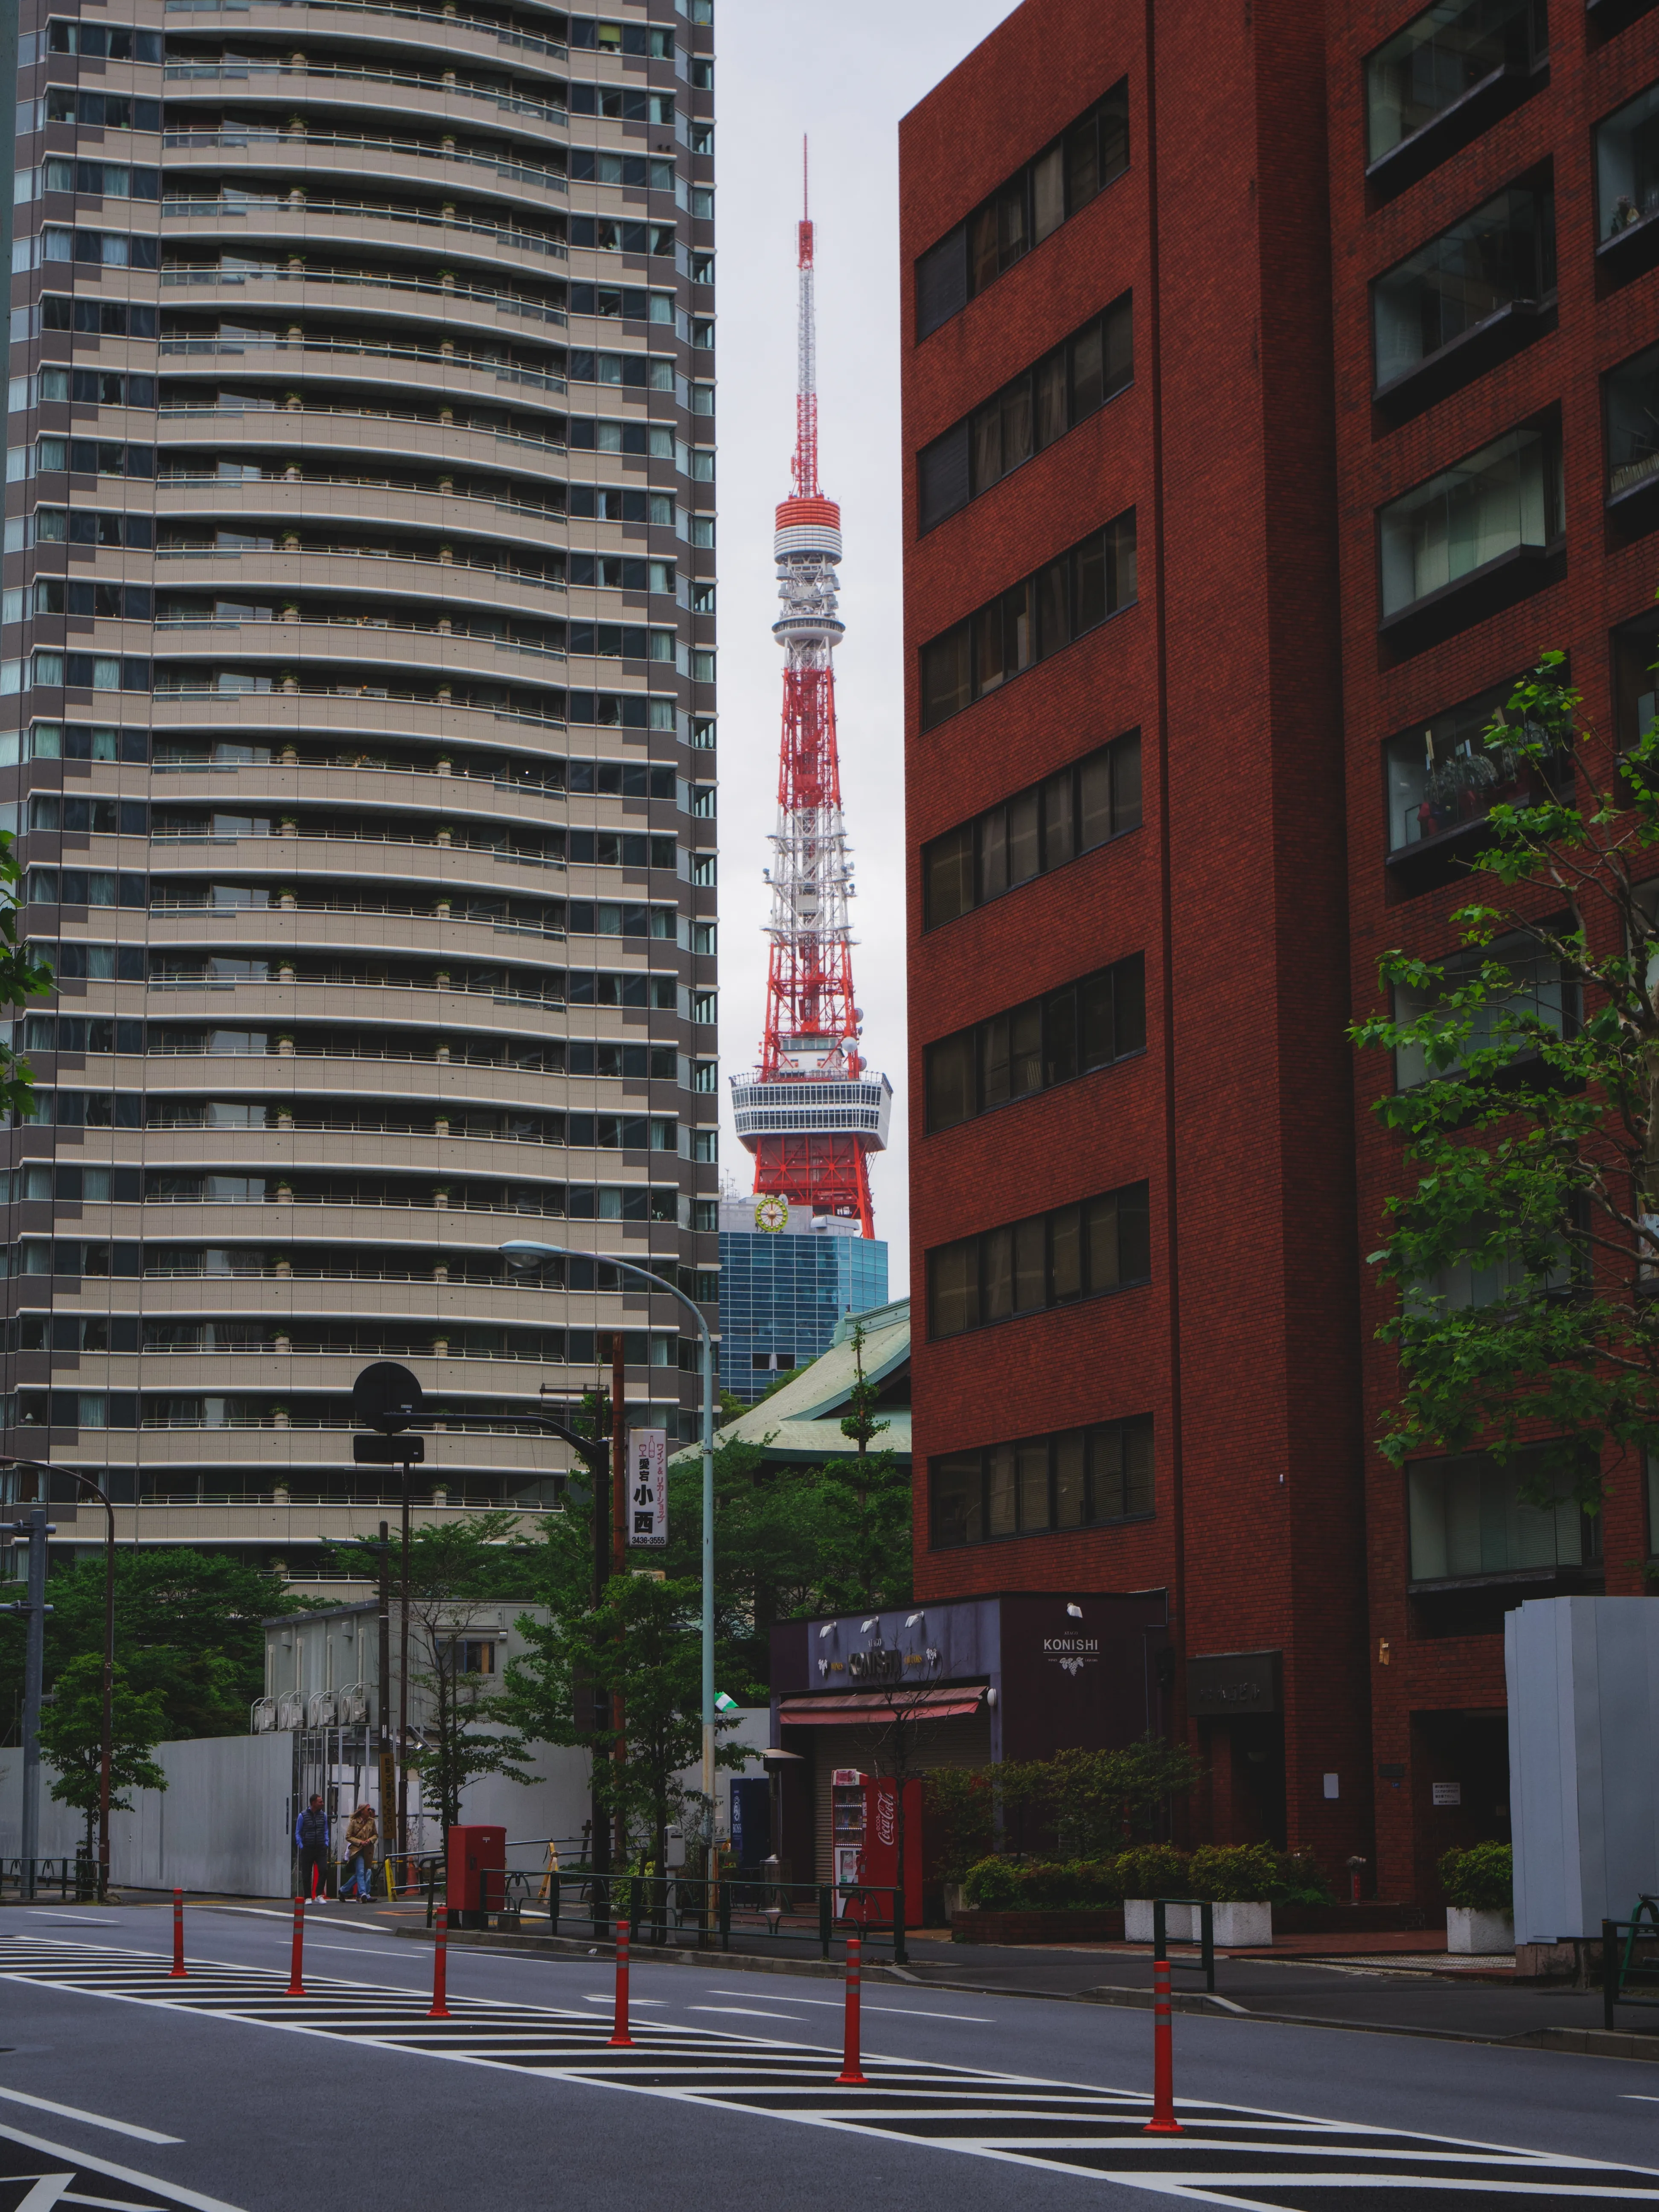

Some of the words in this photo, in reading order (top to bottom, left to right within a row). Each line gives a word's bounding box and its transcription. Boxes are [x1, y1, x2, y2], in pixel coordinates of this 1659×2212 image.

[658, 1467, 663, 1475] &
[657, 1477, 665, 1524] リカーショップ
[868, 1638, 882, 1647] ATAGO
[1044, 1639, 1098, 1650] KONISHI
[848, 1650, 900, 1676] KONISHI
[732, 1823, 742, 1833] BOSS
